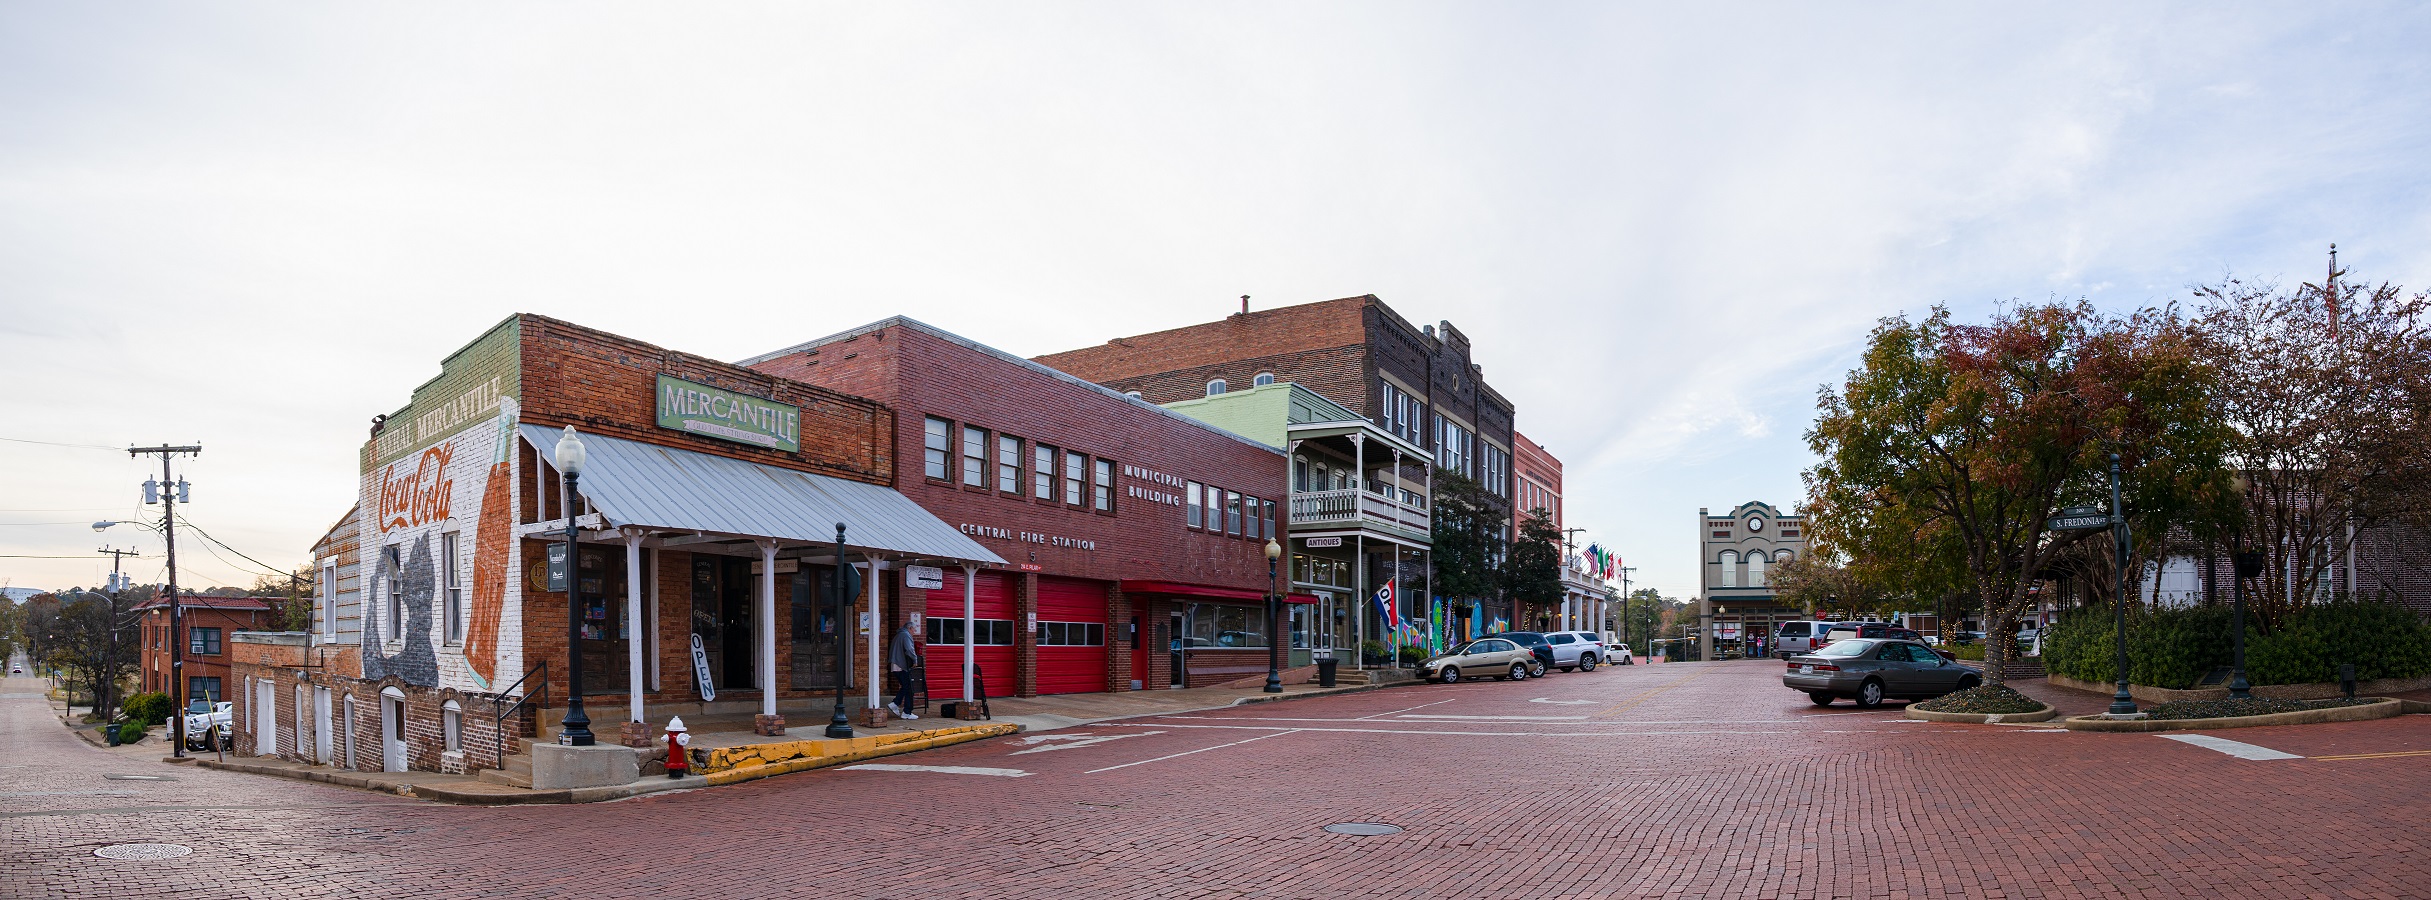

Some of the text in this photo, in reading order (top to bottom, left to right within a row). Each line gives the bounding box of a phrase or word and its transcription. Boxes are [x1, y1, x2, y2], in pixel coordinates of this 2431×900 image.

[714, 389, 748, 401] GENERAL
[417, 375, 501, 443] MERCANTILE
[665, 384, 796, 444] MERCANTILE
[708, 424, 726, 434] TIME
[726, 428, 750, 439] STRING
[751, 433, 768, 443] SHOP
[1124, 464, 1184, 488] MUNICIPAL
[379, 441, 455, 533] Coca-Cola
[1128, 485, 1179, 506] BUILDING
[2056, 519, 2063, 527] S.
[2064, 517, 2100, 527] FREDONIA
[960, 523, 1095, 551] CENTRAL FIRE STATION
[1308, 538, 1340, 547] ANTIQUES
[774, 561, 798, 569] ERCANTILE
[1030, 552, 1036, 562] 5
[691, 635, 714, 697] OPEN
